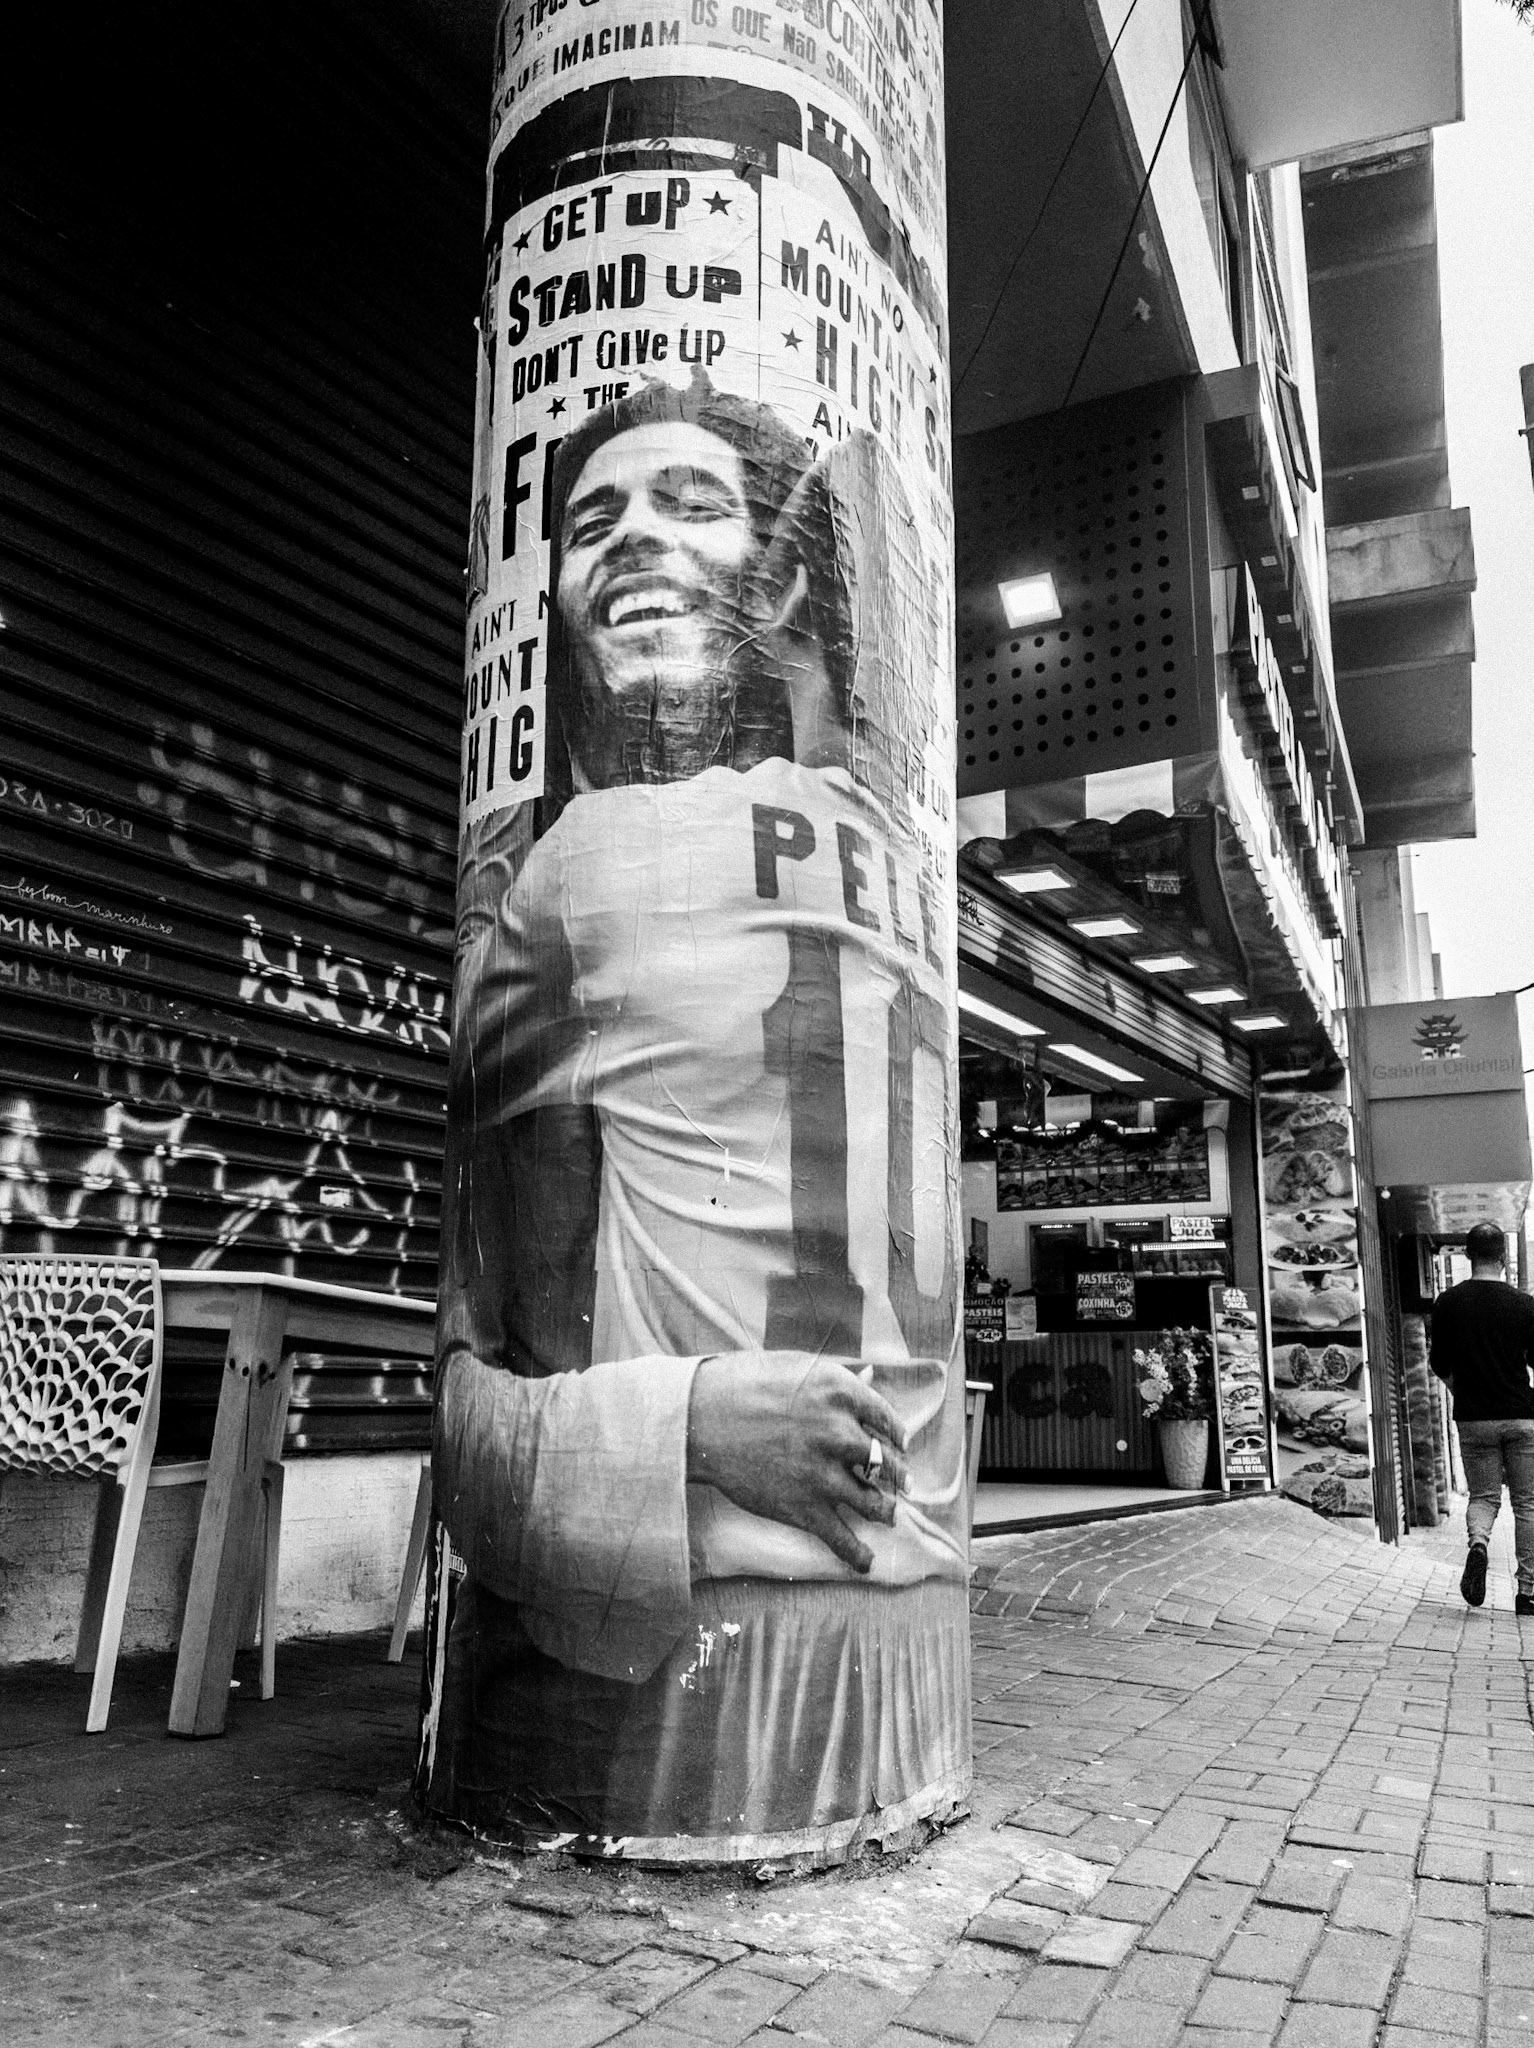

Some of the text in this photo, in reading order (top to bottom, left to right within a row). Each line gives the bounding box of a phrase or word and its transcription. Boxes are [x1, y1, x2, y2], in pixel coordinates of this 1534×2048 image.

[505, 20, 680, 108] QUE IMAGINAM
[691, 0, 718, 28] OS
[732, 6, 771, 43] QUE
[826, 51, 869, 119] SABEM
[543, 178, 690, 252] GET UP
[508, 254, 742, 347] STAND UP
[815, 219, 869, 287] AIN'T
[881, 283, 904, 333] NO
[781, 240, 915, 410] MOUNTAIN
[512, 335, 583, 404] DON'T
[679, 323, 725, 366] UP
[583, 382, 630, 410] THE
[472, 600, 517, 659] AIN'T
[1173, 1217, 1213, 1229] PASTEL
[1179, 1229, 1212, 1238] JUCA
[1077, 1273, 1114, 1285] PASTEL
[1078, 1298, 1116, 1309] COXINHA
